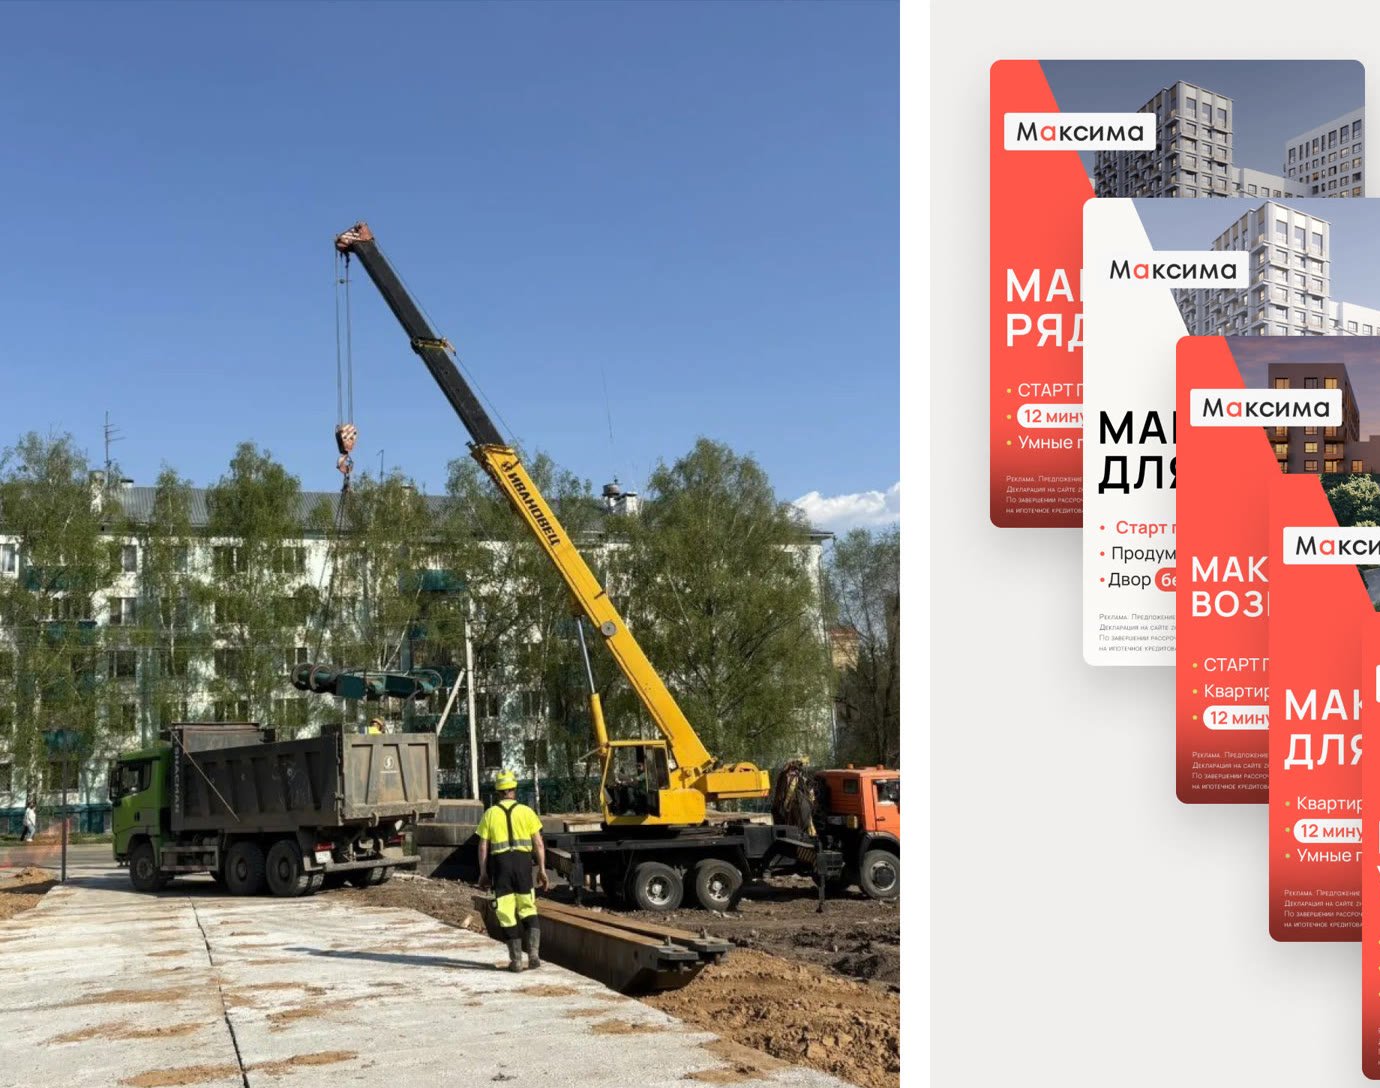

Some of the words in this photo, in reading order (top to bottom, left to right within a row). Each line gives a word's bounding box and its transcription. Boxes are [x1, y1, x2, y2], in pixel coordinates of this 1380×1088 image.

[1017, 122, 1144, 142] Максима
[1110, 260, 1237, 280] Максима
[1007, 269, 1083, 302] МА
[1018, 383, 1074, 397] СТАРТ
[1024, 409, 1042, 423] 12
[1203, 398, 1330, 418] Максима
[1100, 411, 1176, 444] МА
[1018, 435, 1073, 449] Умные
[1098, 455, 1176, 494] ДЛ
[508, 472, 561, 546] ИВАНОВЕЦ
[1116, 520, 1168, 538] Старт
[1108, 572, 1152, 590] Двор
[1192, 590, 1269, 617] ВОЗ
[1204, 657, 1260, 672] СТАРТ
[1210, 711, 1228, 725] 12
[1301, 824, 1319, 838] 12
[1297, 848, 1352, 862] Умные
